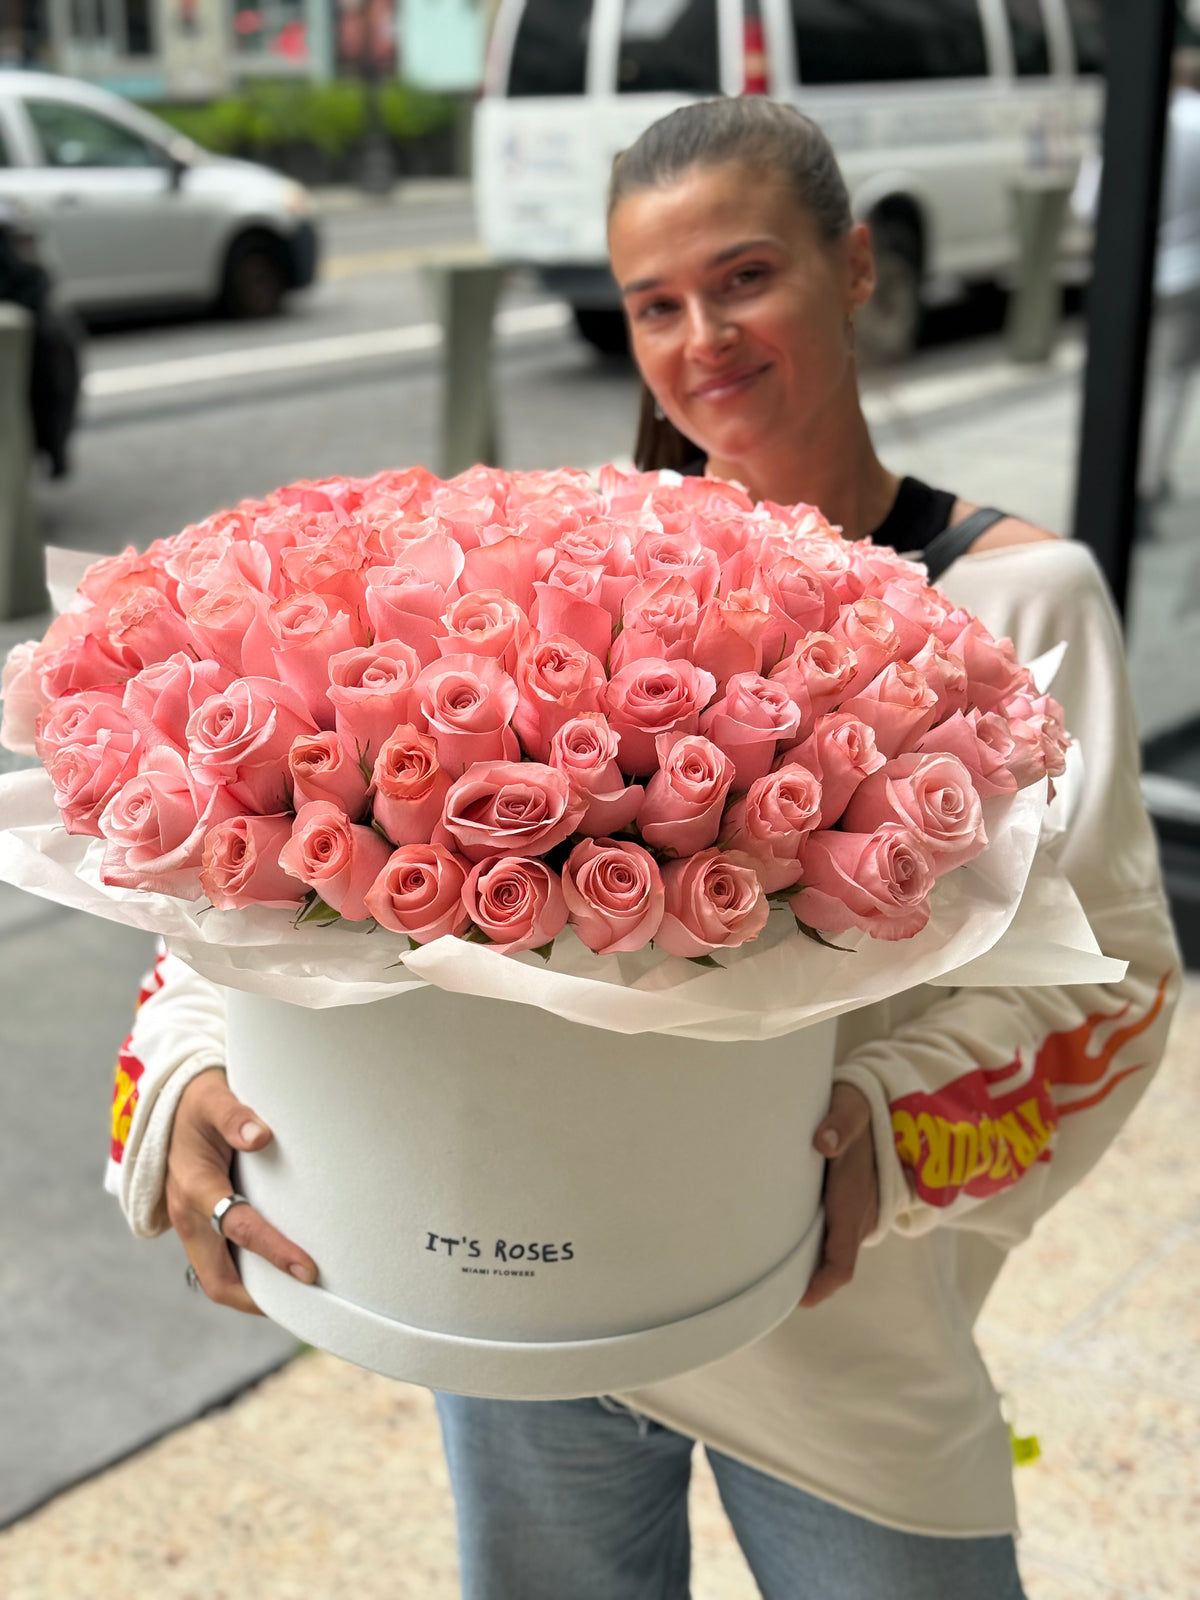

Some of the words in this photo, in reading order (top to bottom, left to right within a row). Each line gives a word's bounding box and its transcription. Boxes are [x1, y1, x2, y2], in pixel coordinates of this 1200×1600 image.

[425, 1231, 481, 1258] IT'S
[494, 1239, 574, 1263] ROSES
[461, 1266, 490, 1275] MIAMI
[493, 1268, 535, 1277] FLOWERS
